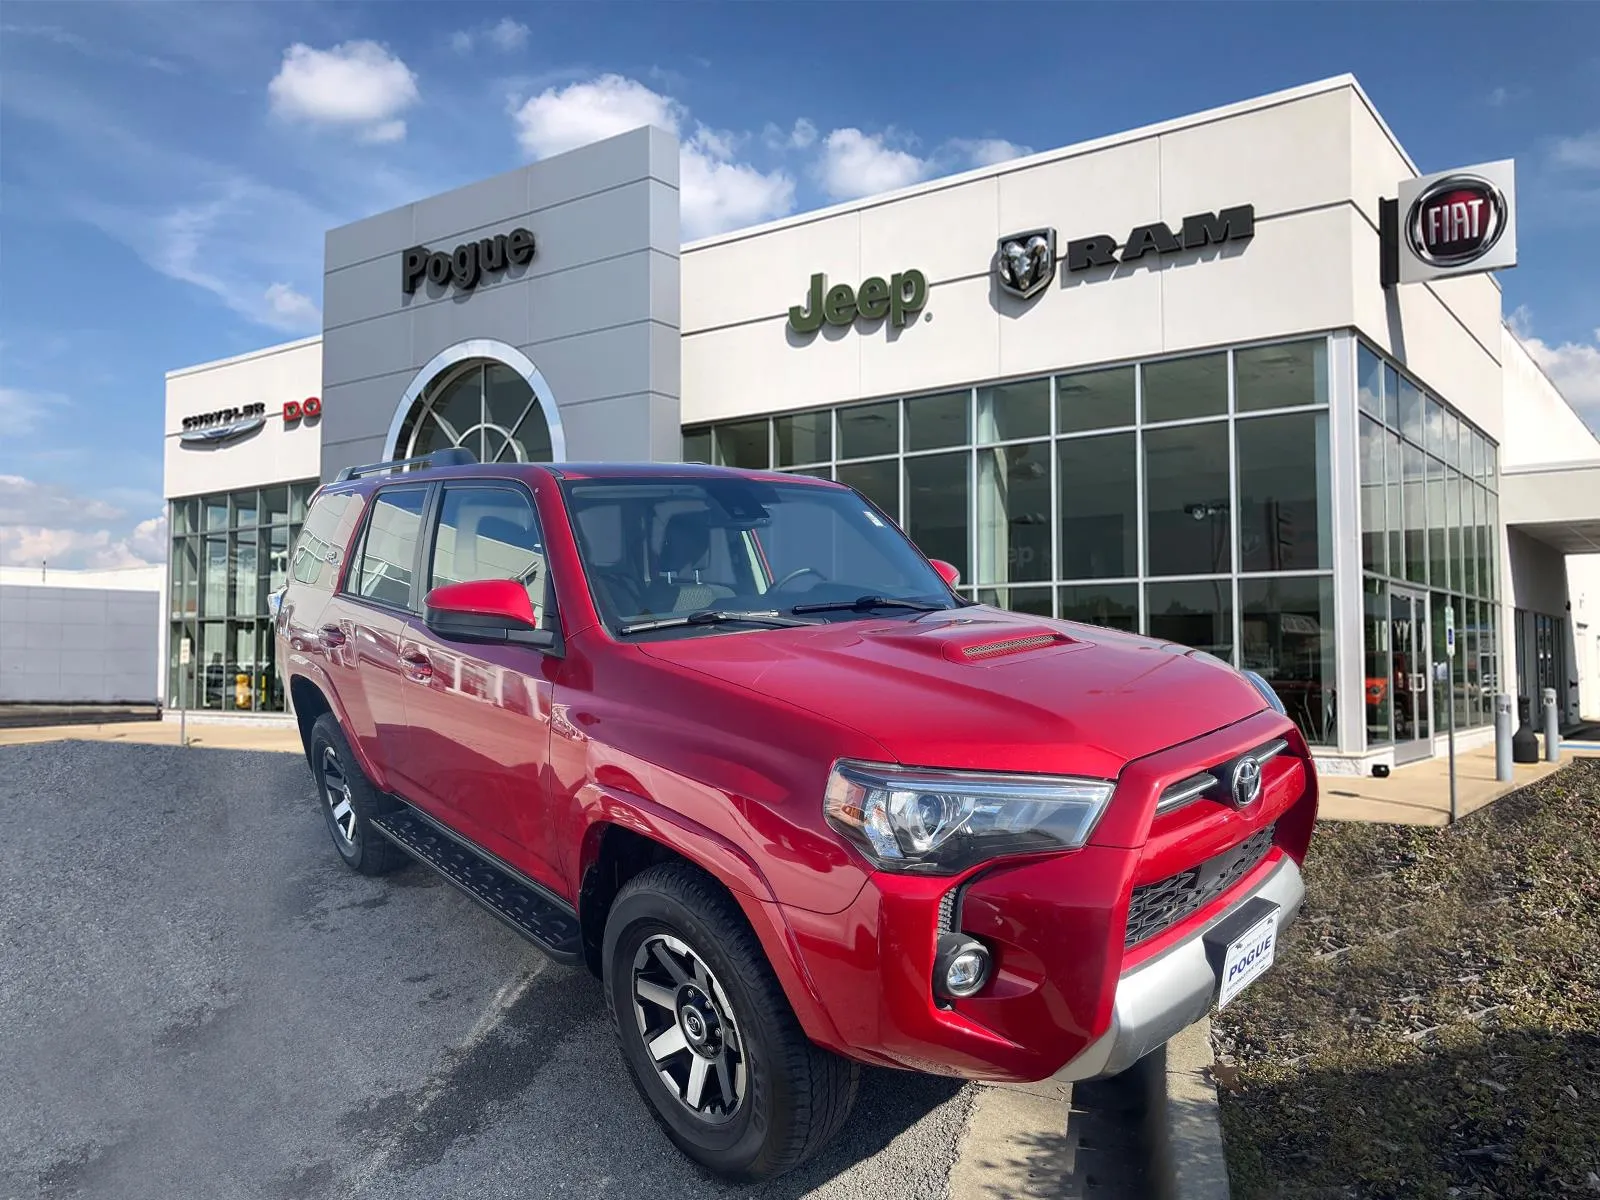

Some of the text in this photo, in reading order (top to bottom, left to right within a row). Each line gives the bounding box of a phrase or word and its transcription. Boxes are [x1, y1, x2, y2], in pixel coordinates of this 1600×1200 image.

[1067, 203, 1255, 272] RAM
[1428, 198, 1484, 246] FIAT
[402, 227, 535, 294] Pogue
[788, 267, 930, 334] Jeep
[182, 401, 265, 428] CHRYSLER
[1228, 934, 1273, 982] POGUE
